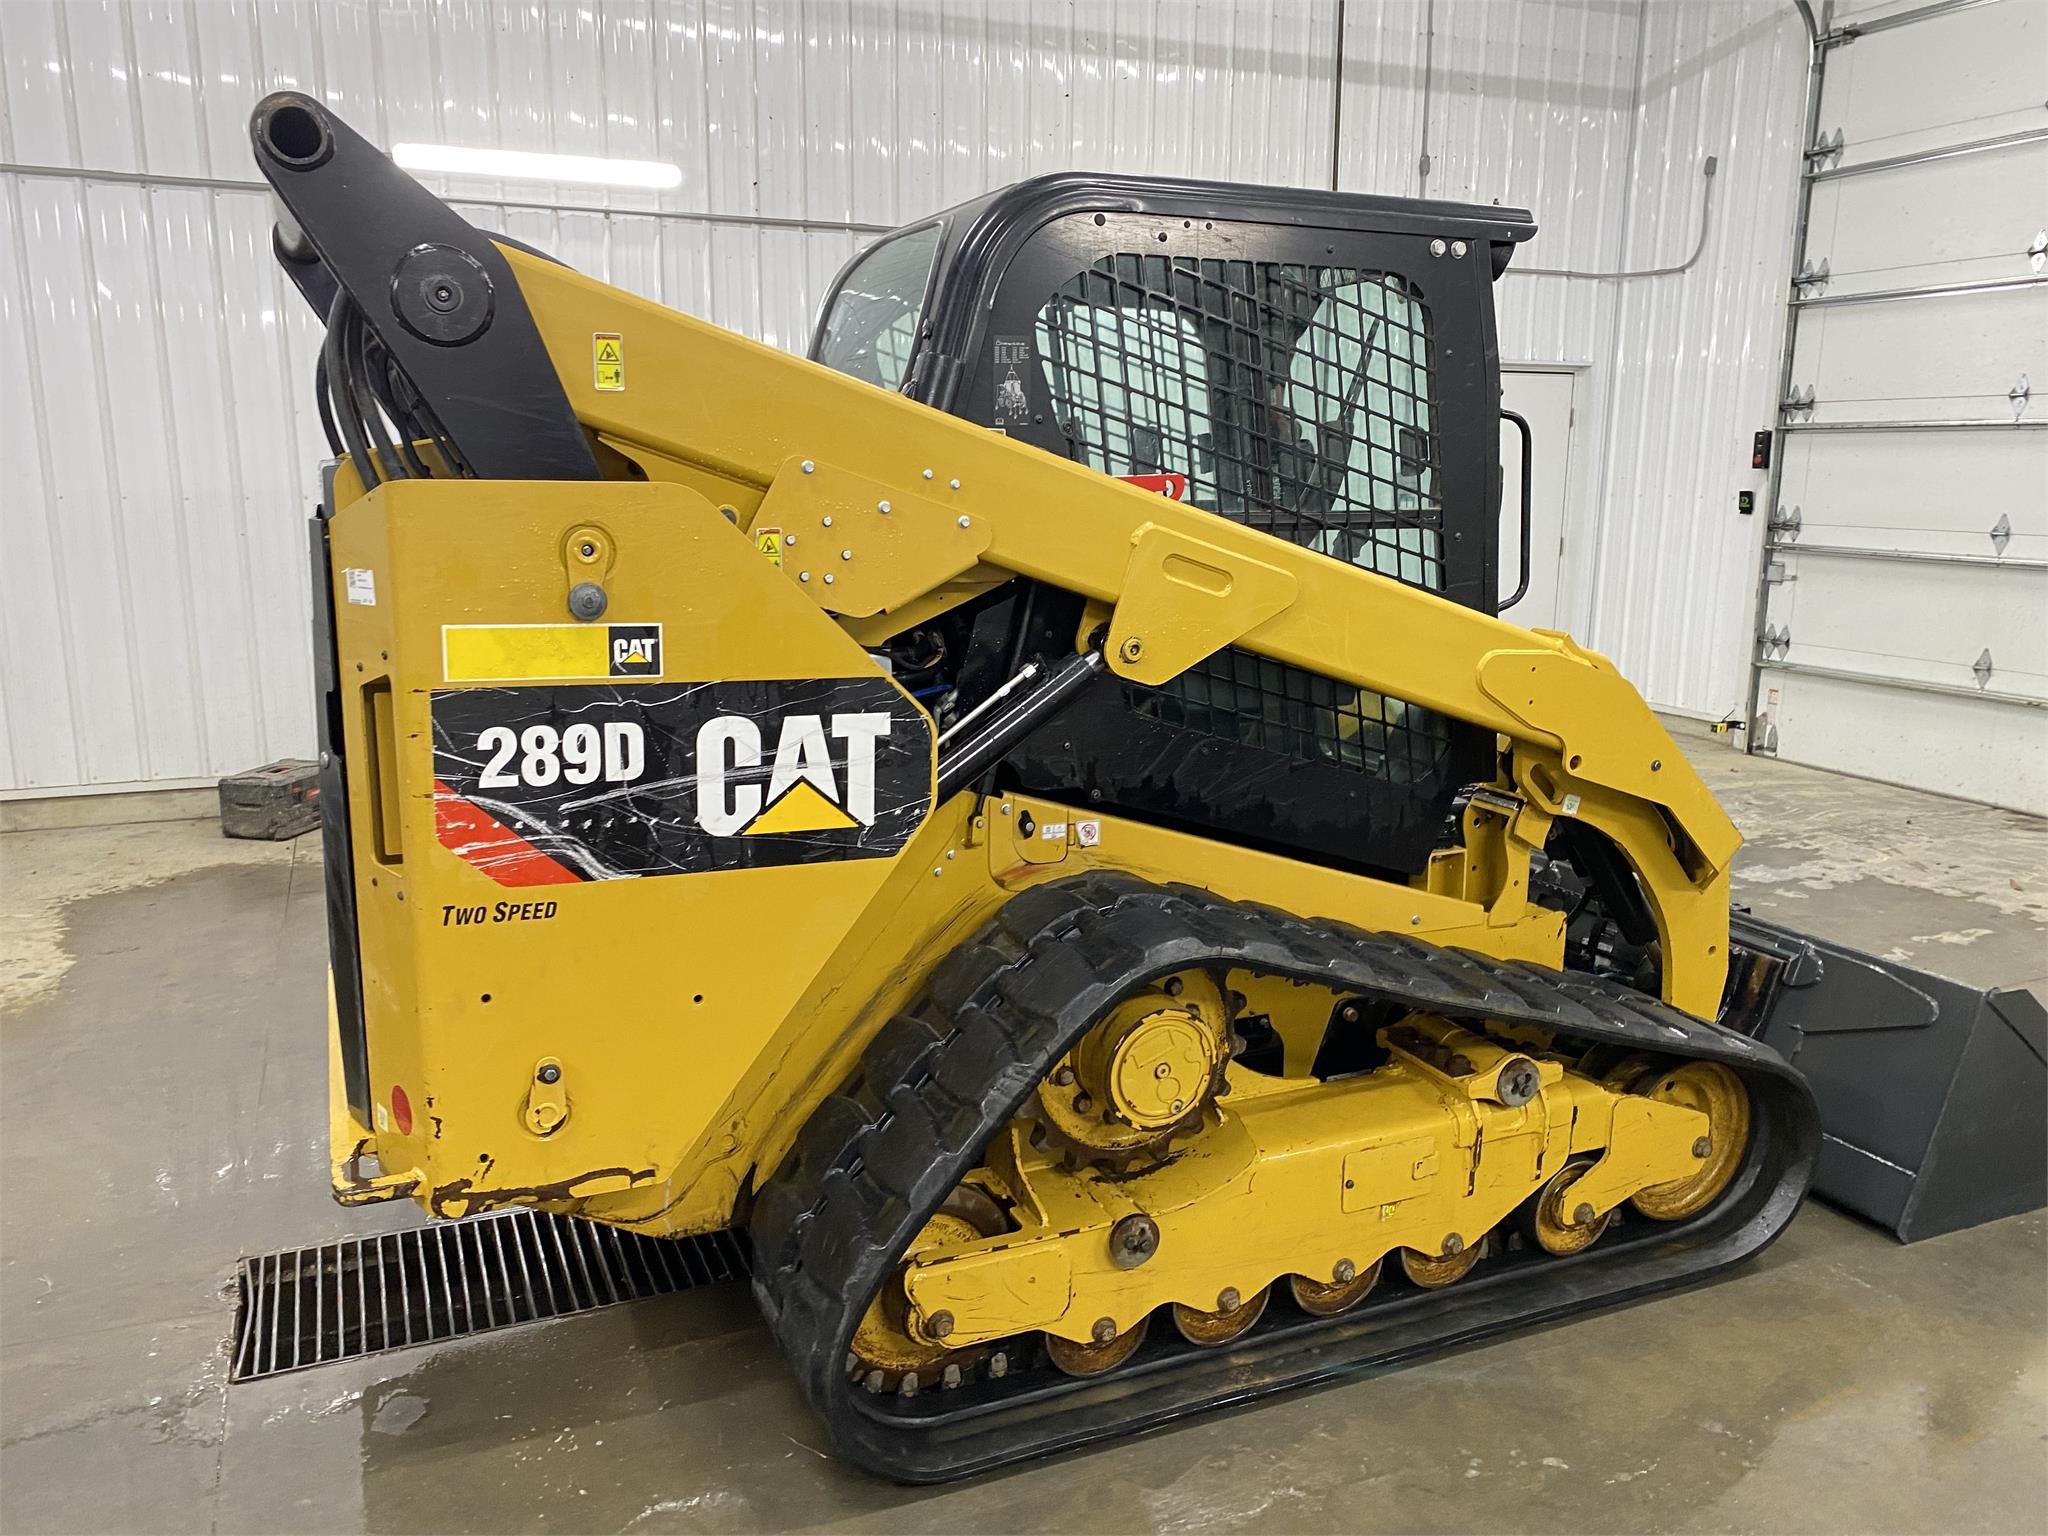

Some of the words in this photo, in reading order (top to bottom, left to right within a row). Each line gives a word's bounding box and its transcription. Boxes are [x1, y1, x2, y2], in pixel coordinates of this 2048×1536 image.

[613, 638, 656, 664] CAT
[476, 721, 645, 789] 289D
[696, 711, 892, 838] CAT
